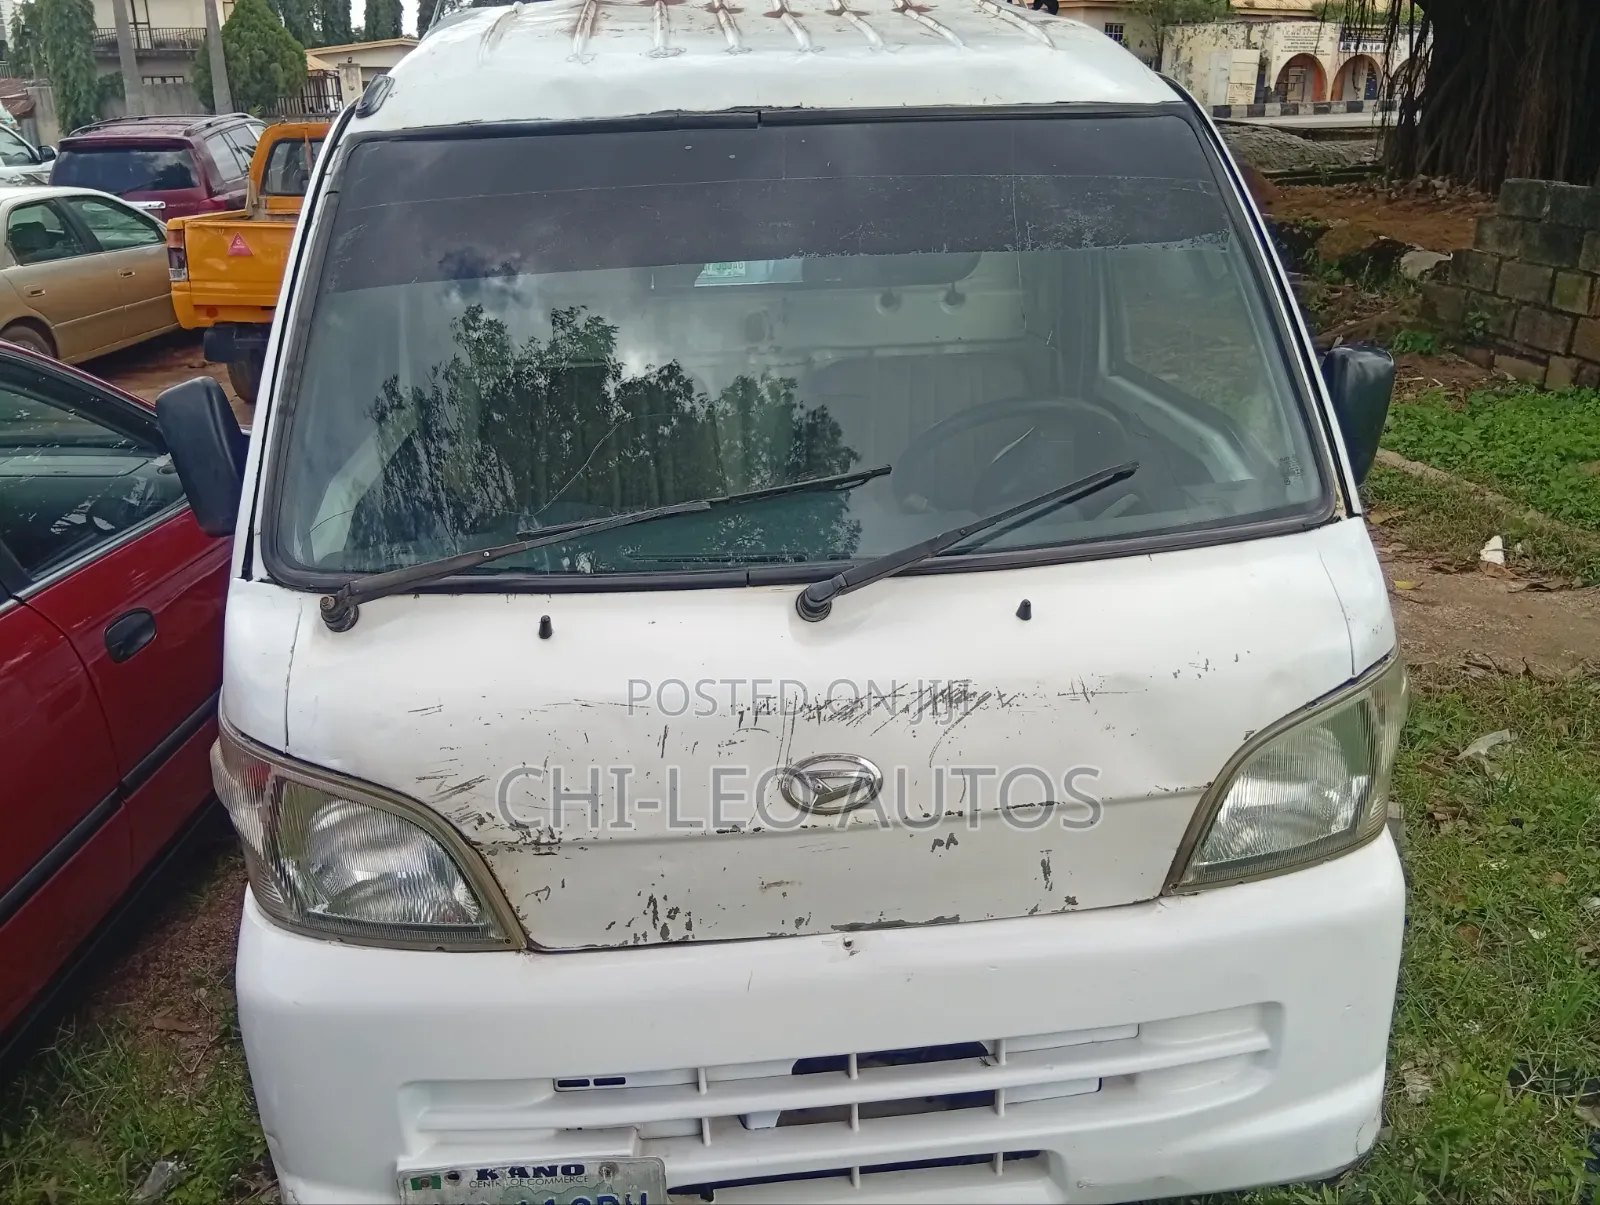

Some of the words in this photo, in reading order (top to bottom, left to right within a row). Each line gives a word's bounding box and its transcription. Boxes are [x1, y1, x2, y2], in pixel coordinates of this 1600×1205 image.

[476, 1164, 585, 1181] KANO
[510, 1177, 524, 1187] OF
[527, 1175, 589, 1186] COMMERCE
